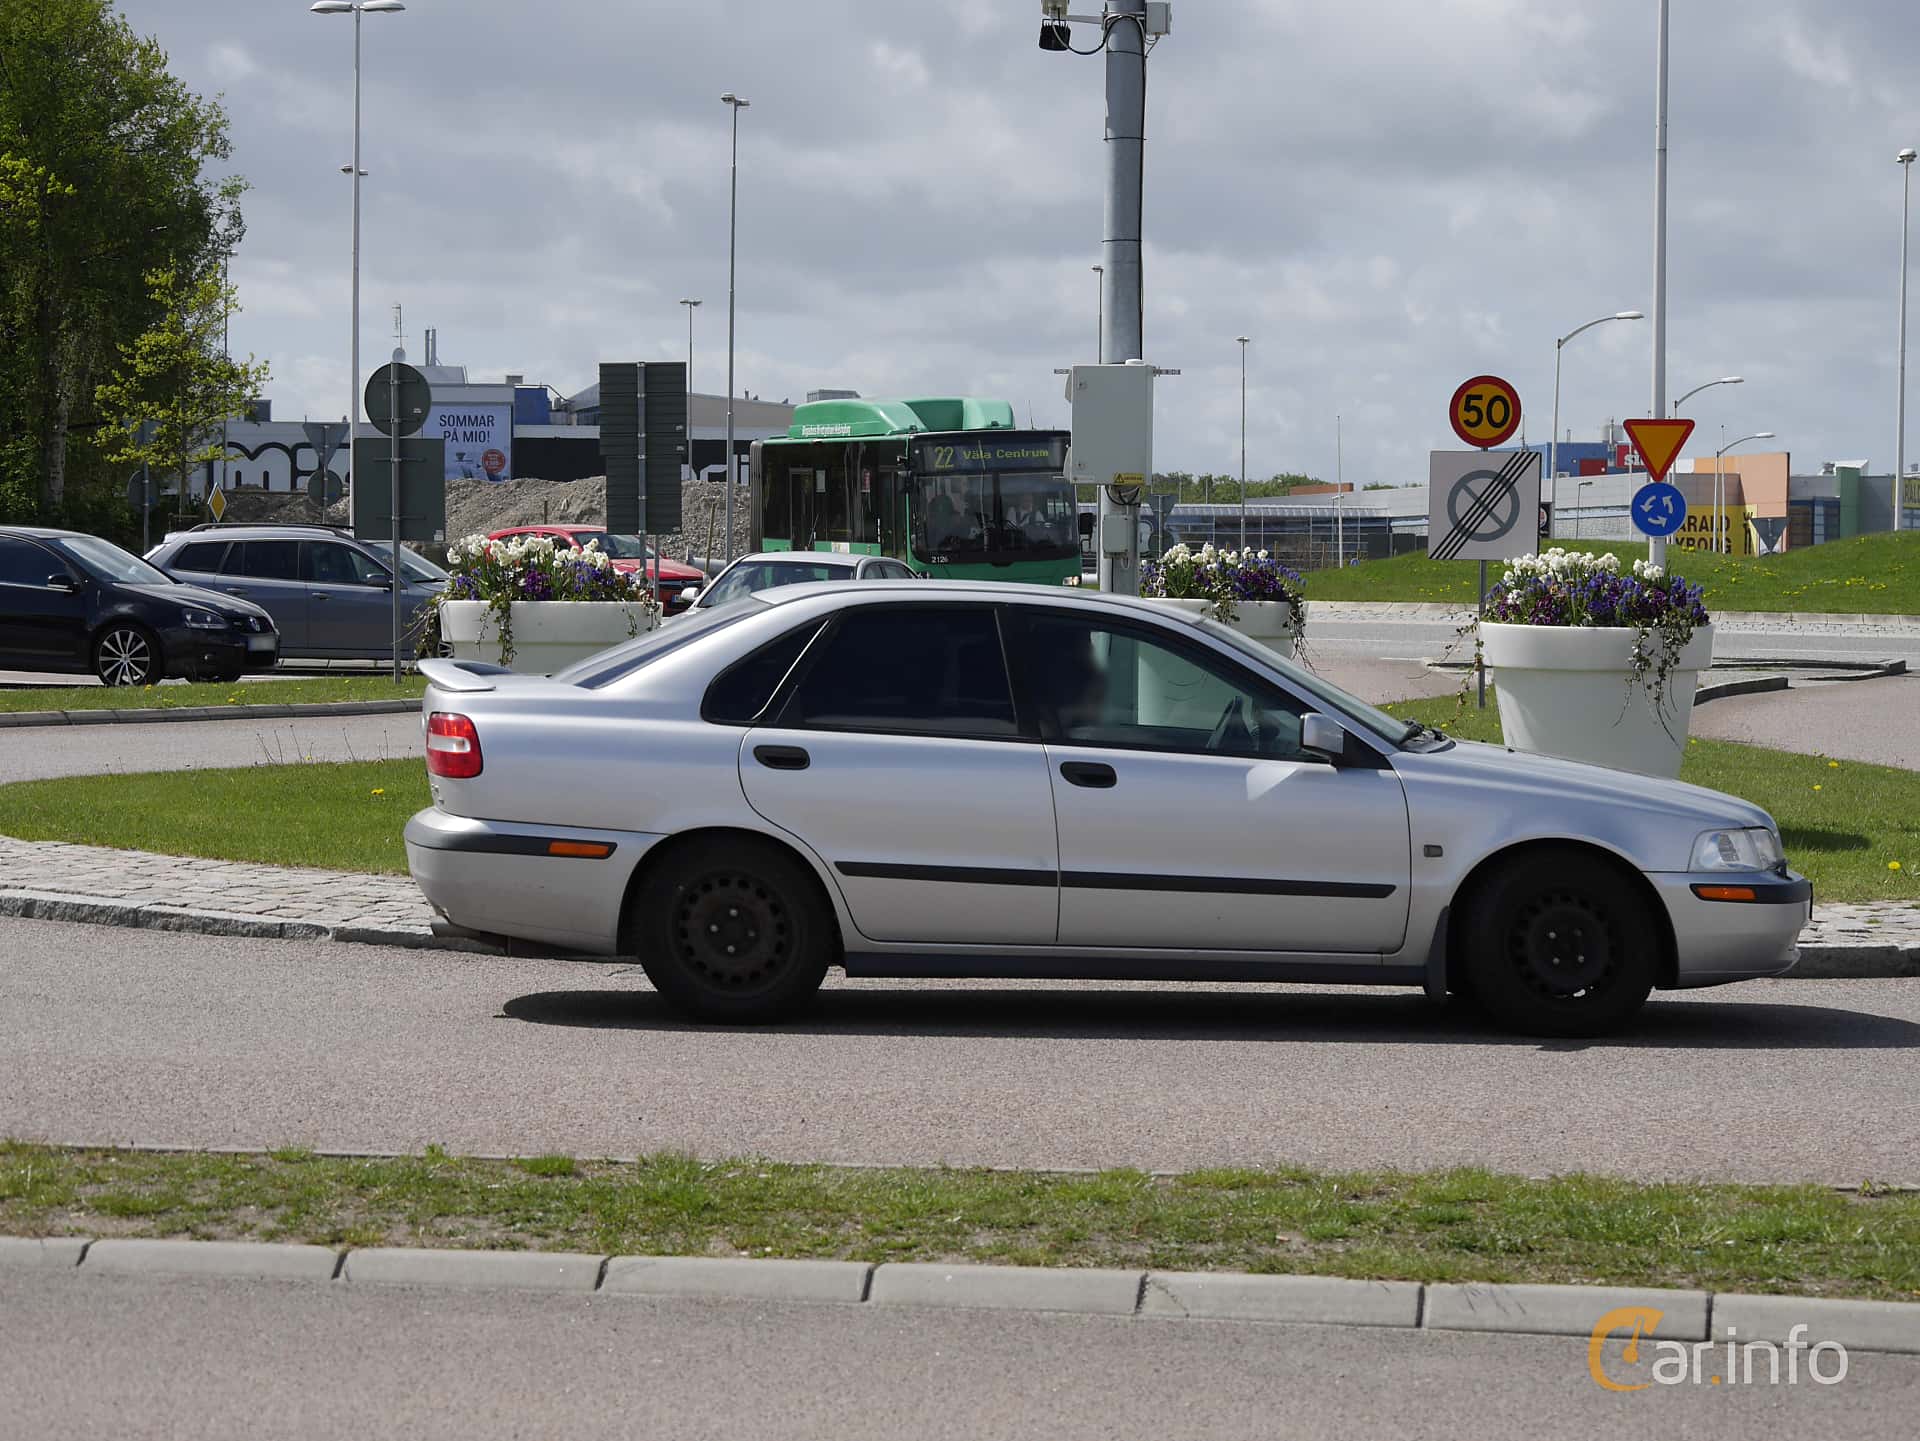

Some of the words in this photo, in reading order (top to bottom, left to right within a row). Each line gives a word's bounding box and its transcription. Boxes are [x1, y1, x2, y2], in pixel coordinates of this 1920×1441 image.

[1463, 394, 1511, 429] 50
[439, 414, 495, 428] SOMMAR
[443, 428, 459, 443] PÅ
[463, 430, 490, 443] MIO!
[934, 446, 954, 468] 22
[996, 448, 1049, 458] Centrum
[1677, 515, 1731, 533] ARALD
